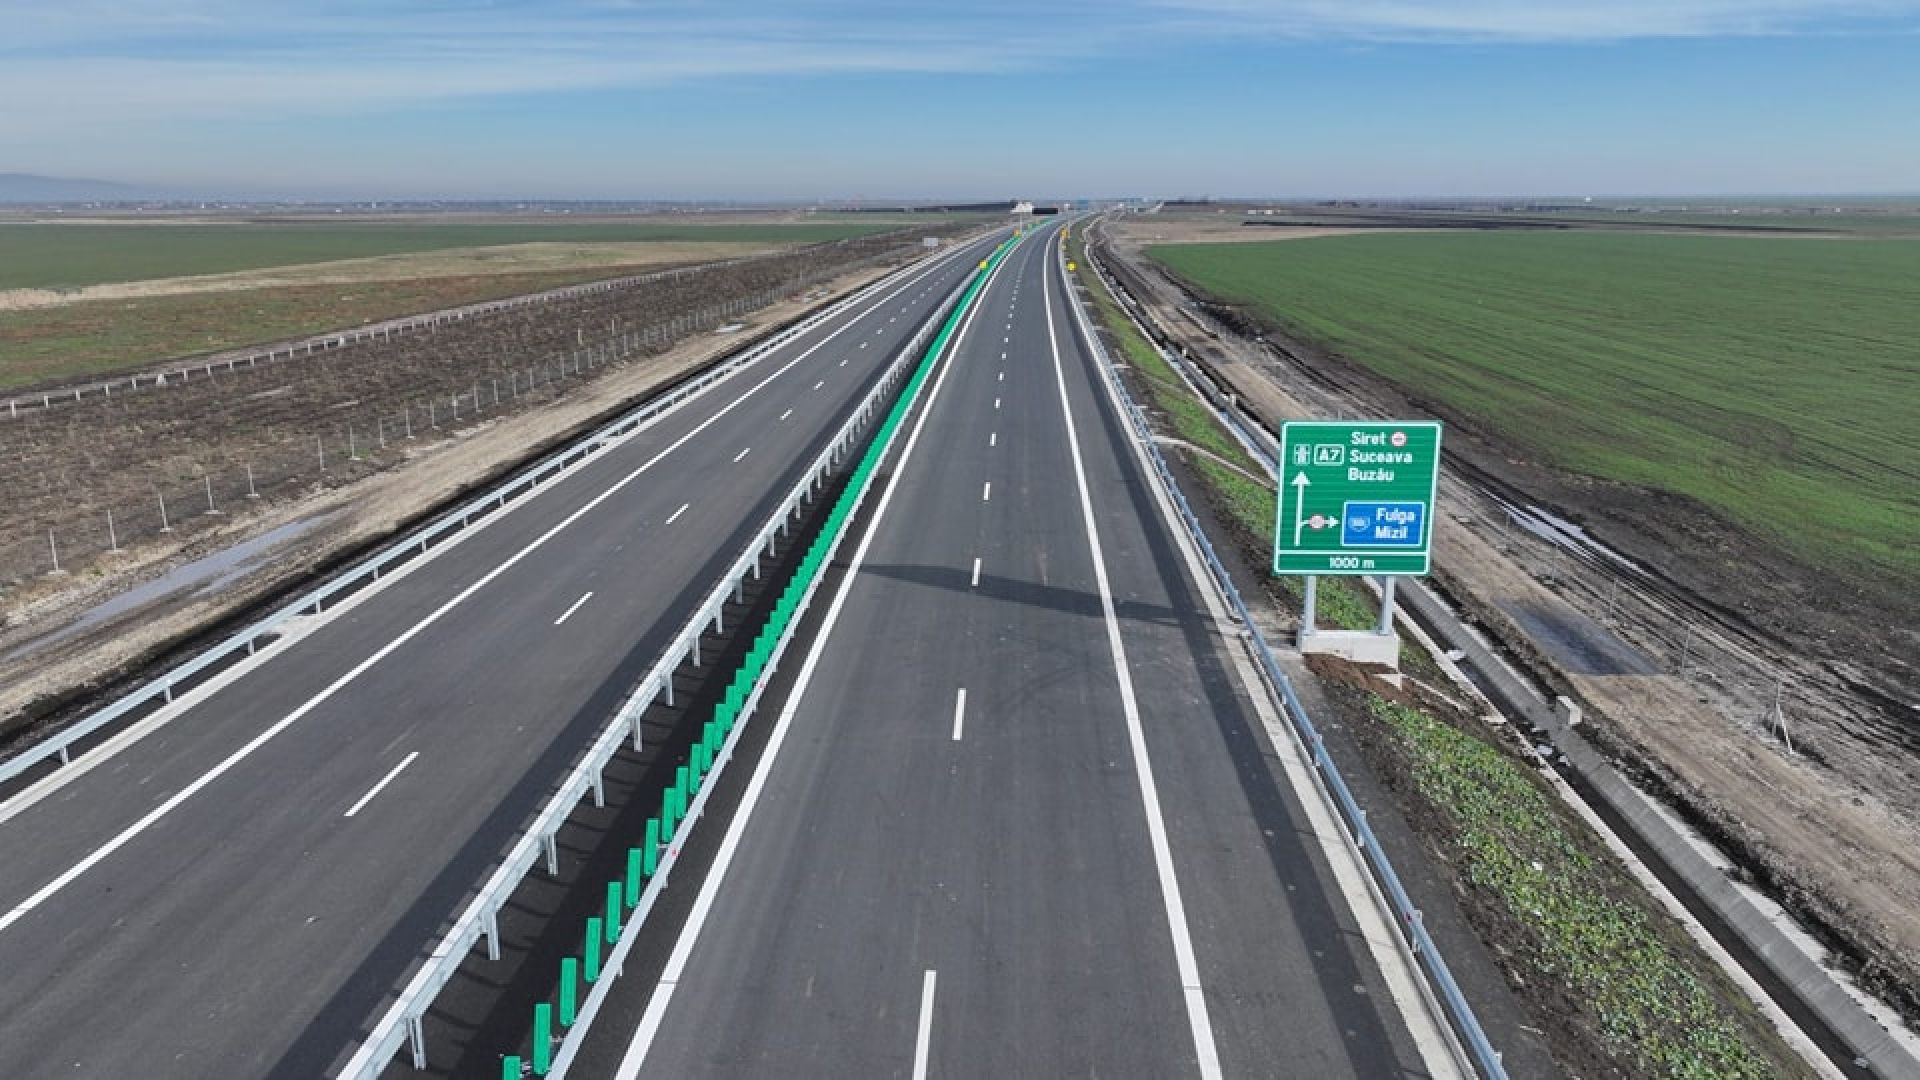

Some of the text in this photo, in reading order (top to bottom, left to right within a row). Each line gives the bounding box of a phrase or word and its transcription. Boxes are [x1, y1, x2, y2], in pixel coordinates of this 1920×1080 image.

[1351, 431, 1387, 445] Siret
[1318, 450, 1341, 461] A7
[1350, 450, 1413, 463] Suceava
[1375, 507, 1416, 524] Fulga
[1375, 525, 1409, 539] Mizil
[1329, 557, 1375, 569] 1000 m
